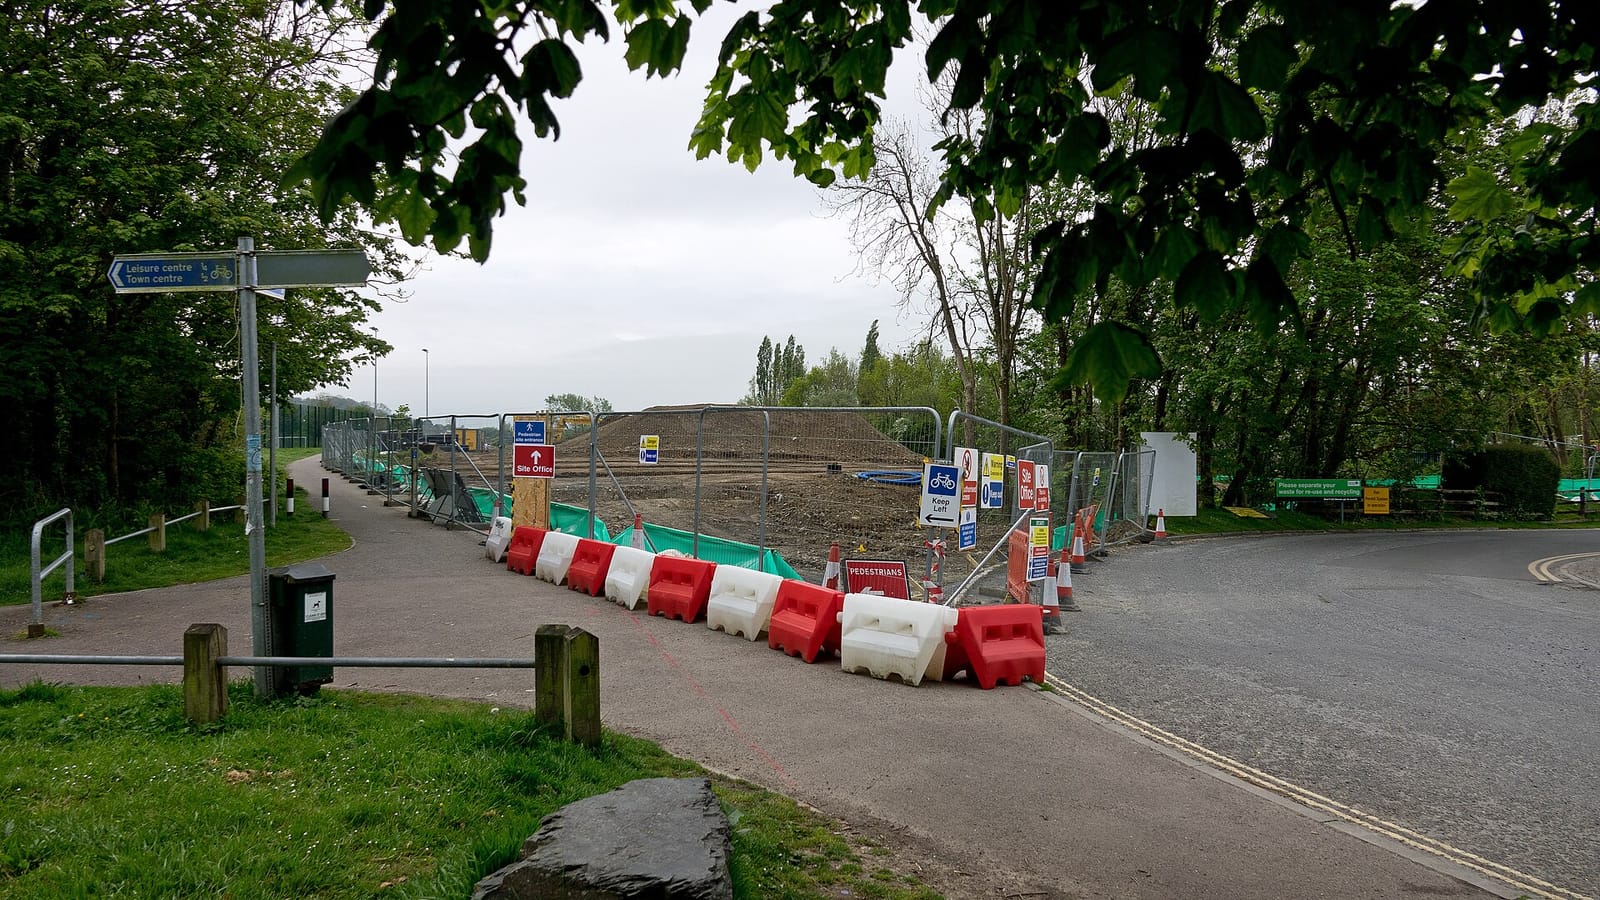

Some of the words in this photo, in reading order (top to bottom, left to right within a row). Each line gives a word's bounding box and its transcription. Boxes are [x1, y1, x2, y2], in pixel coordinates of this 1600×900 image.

[126, 264, 160, 273] Leisure
[162, 263, 193, 272] centre
[126, 275, 151, 283] Town
[153, 274, 183, 283] centre
[517, 465, 531, 473] Site
[532, 465, 553, 473] Office
[1022, 468, 1031, 483] Site
[1021, 485, 1033, 500] Office
[931, 497, 950, 506] Keep
[933, 505, 947, 513] Left
[850, 568, 903, 576] PEDESTRIANS
